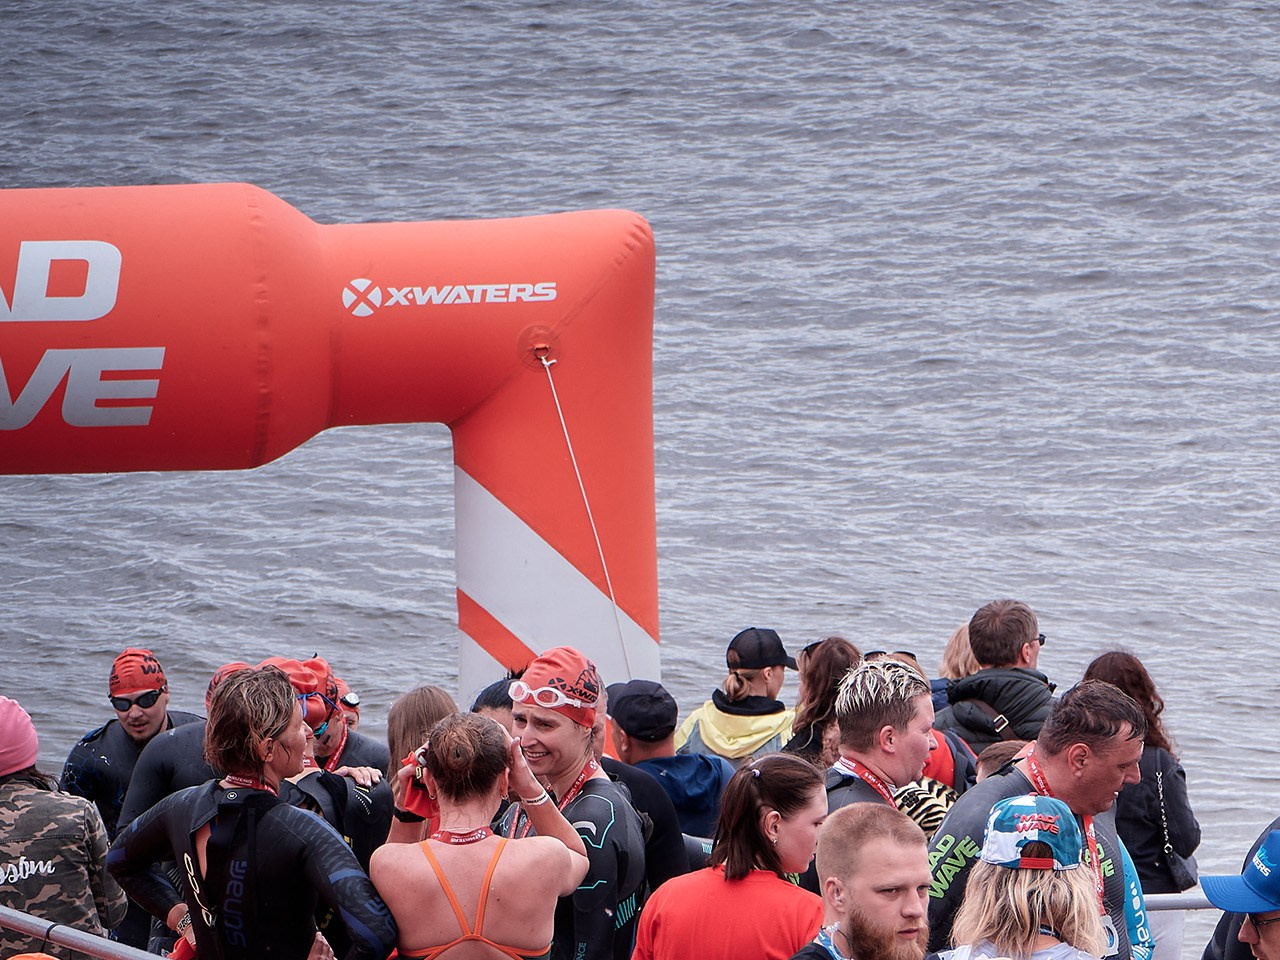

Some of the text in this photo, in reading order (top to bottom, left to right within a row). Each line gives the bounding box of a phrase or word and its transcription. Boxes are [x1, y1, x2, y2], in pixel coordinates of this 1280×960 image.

[1016, 822, 1061, 836] WAVE
[1019, 814, 1055, 824] MAD
[928, 834, 956, 873] AD
[928, 835, 981, 899] WAVE
[183, 852, 213, 927] orca
